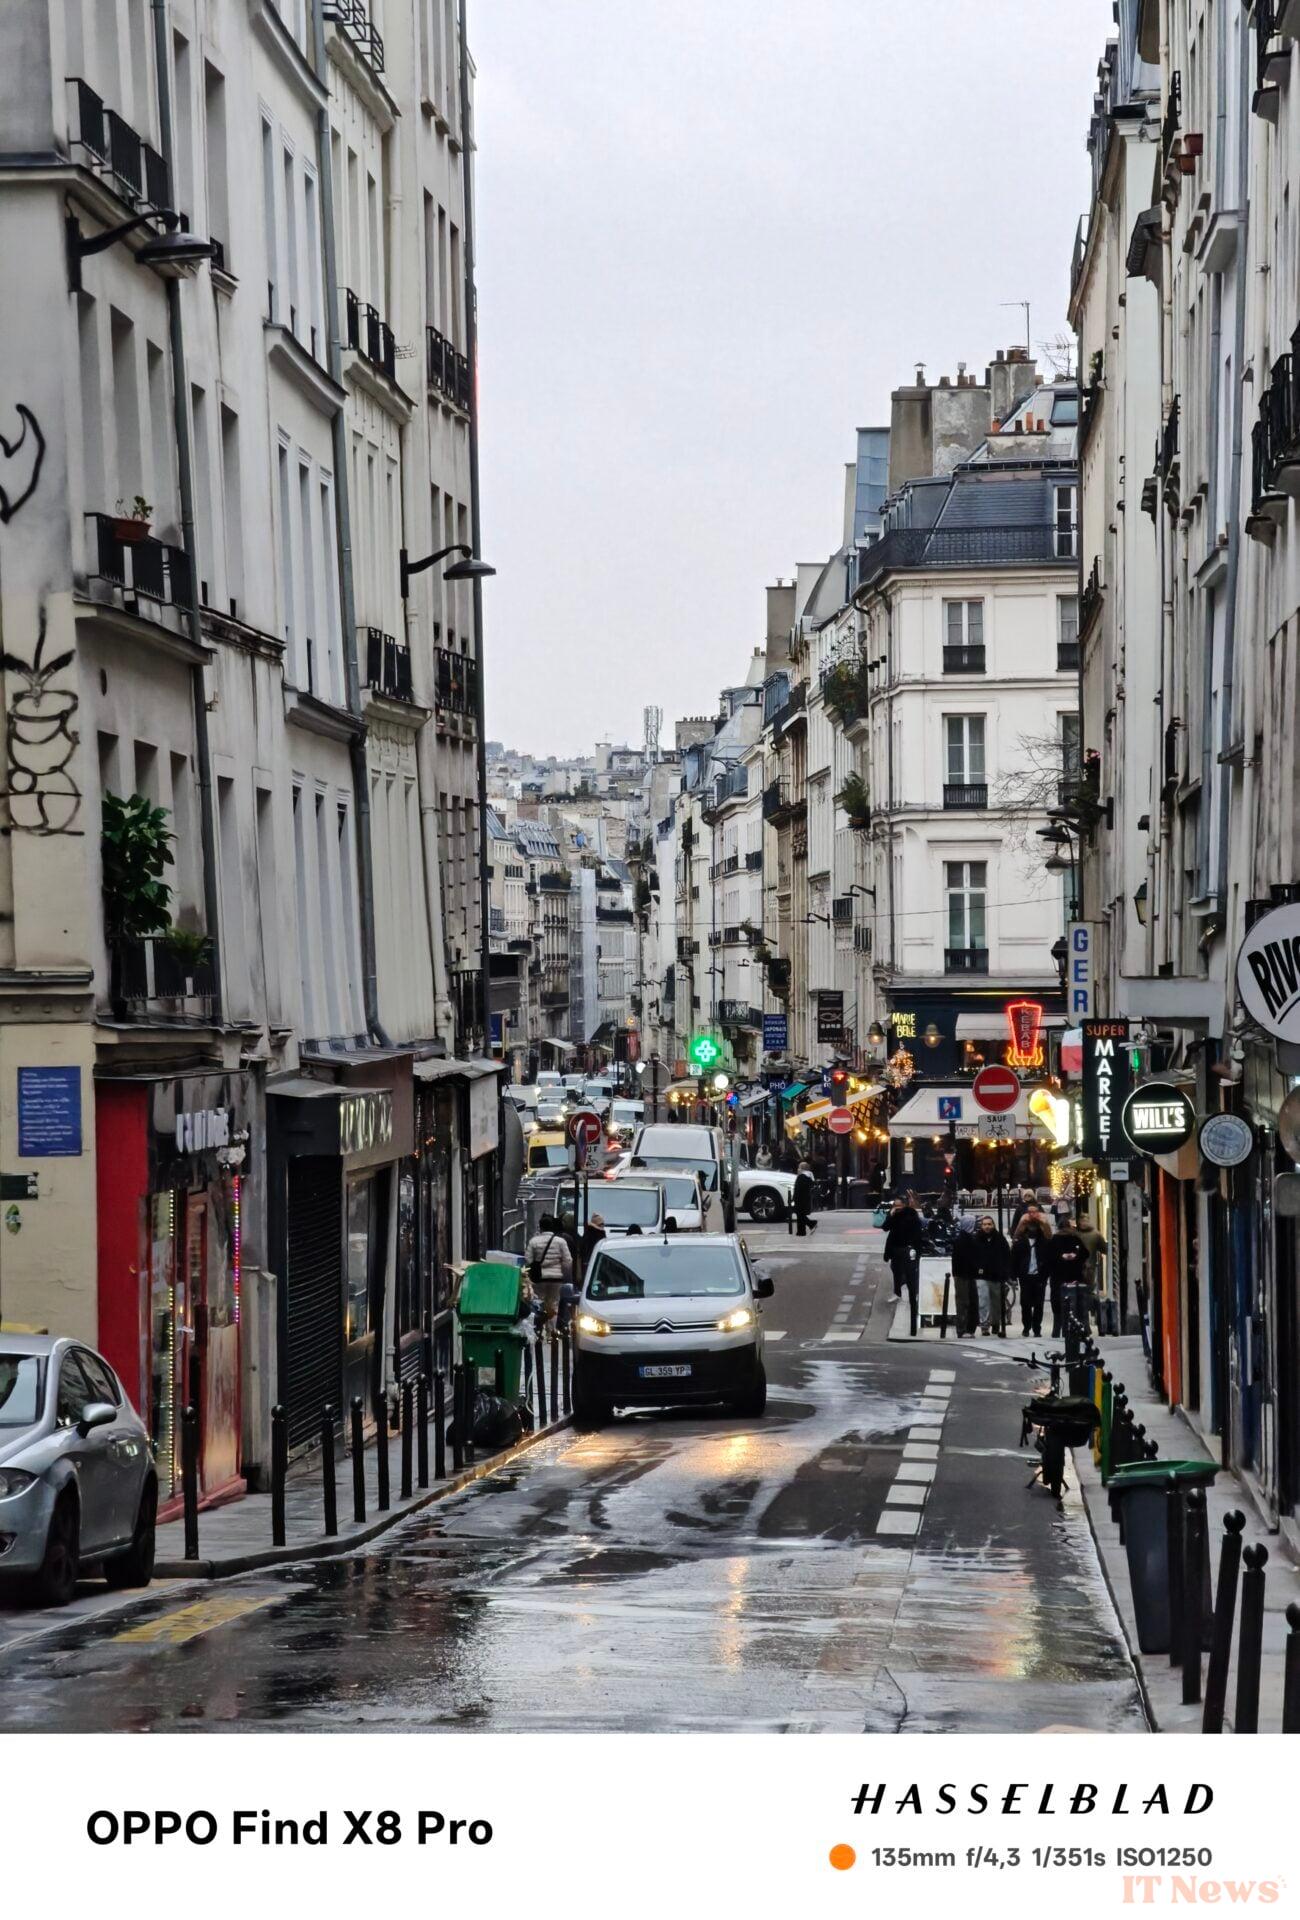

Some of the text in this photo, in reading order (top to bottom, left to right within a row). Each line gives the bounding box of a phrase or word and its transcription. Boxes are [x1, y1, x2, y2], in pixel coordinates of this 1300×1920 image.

[892, 1012, 916, 1025] MARIE
[1021, 1008, 1031, 1048] KEBAB
[1086, 1024, 1125, 1037] SUPER
[1095, 1039, 1114, 1152] MARKET
[1133, 1107, 1185, 1129] WILL'S
[658, 1367, 673, 1376] 359
